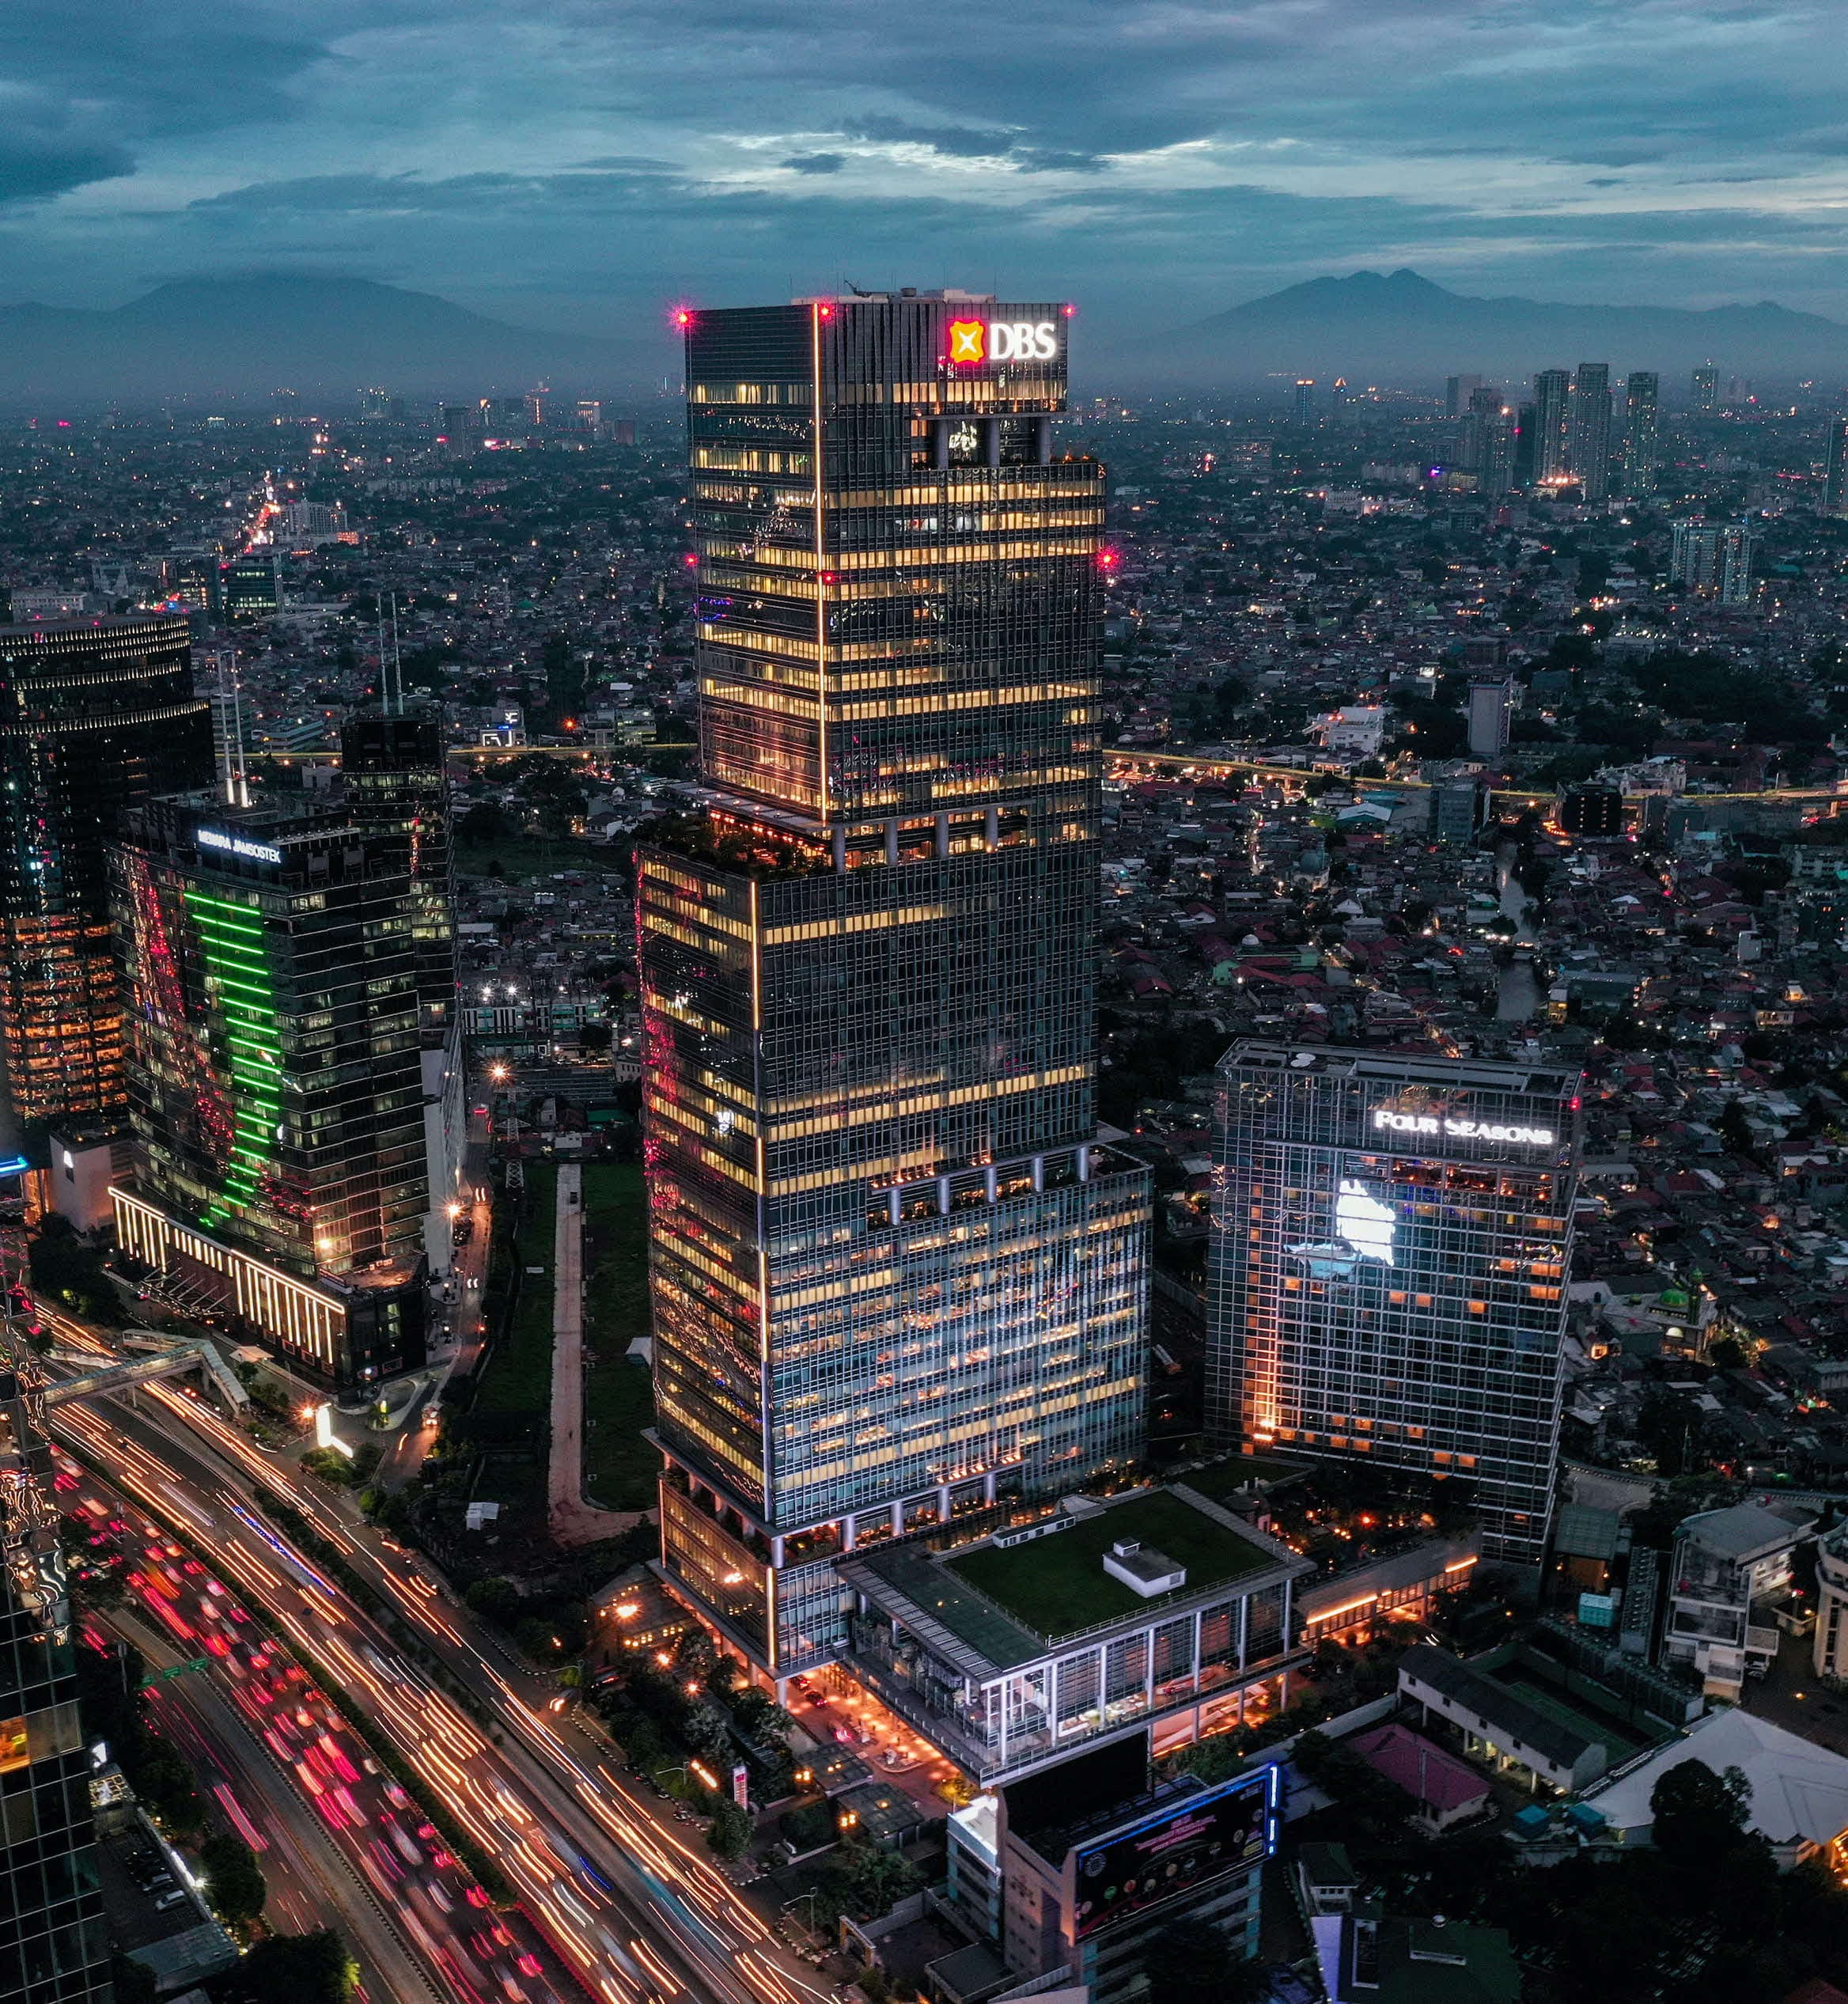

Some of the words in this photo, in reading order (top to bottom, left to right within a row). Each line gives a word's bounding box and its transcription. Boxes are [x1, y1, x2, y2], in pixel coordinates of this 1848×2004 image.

[990, 323, 1056, 360] DBS
[1375, 1110, 1438, 1134] FOUR
[1444, 1118, 1553, 1145] SEASONS
